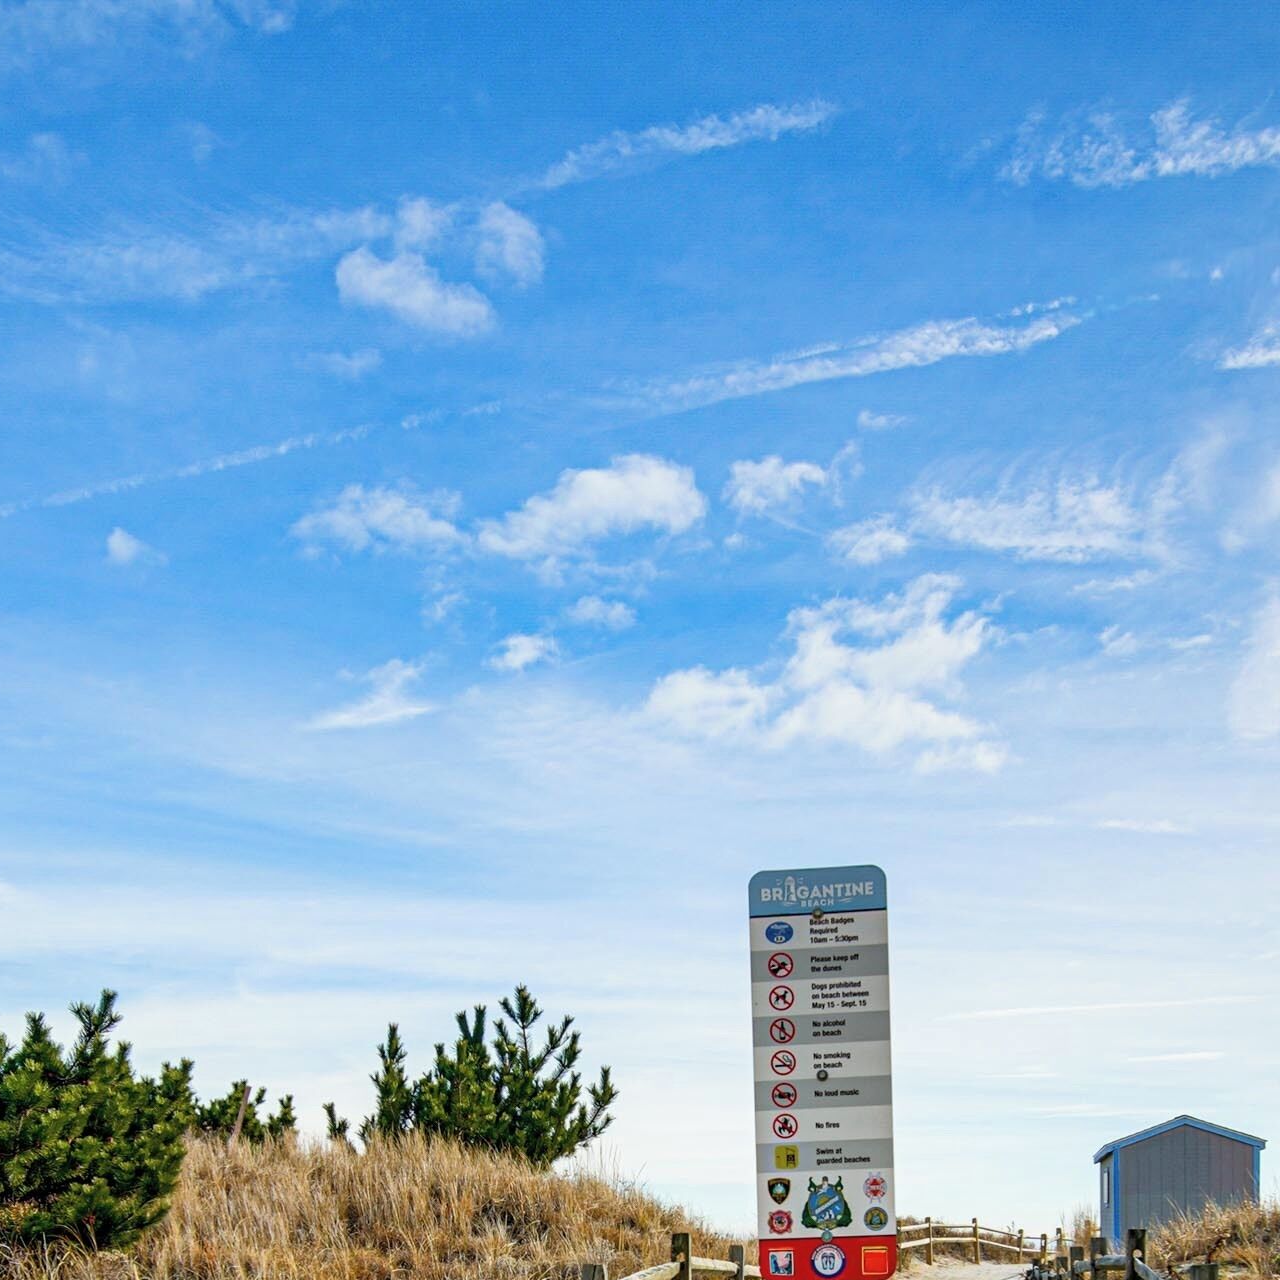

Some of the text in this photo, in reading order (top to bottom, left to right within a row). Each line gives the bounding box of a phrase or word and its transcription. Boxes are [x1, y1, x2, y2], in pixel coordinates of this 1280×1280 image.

[760, 877, 874, 901] BRIGANTINE
[800, 899, 834, 907] BEACH
[831, 917, 854, 925] Badges
[829, 981, 861, 990] prohibited
[824, 1051, 851, 1060] smoking
[817, 1157, 842, 1166] guarded
